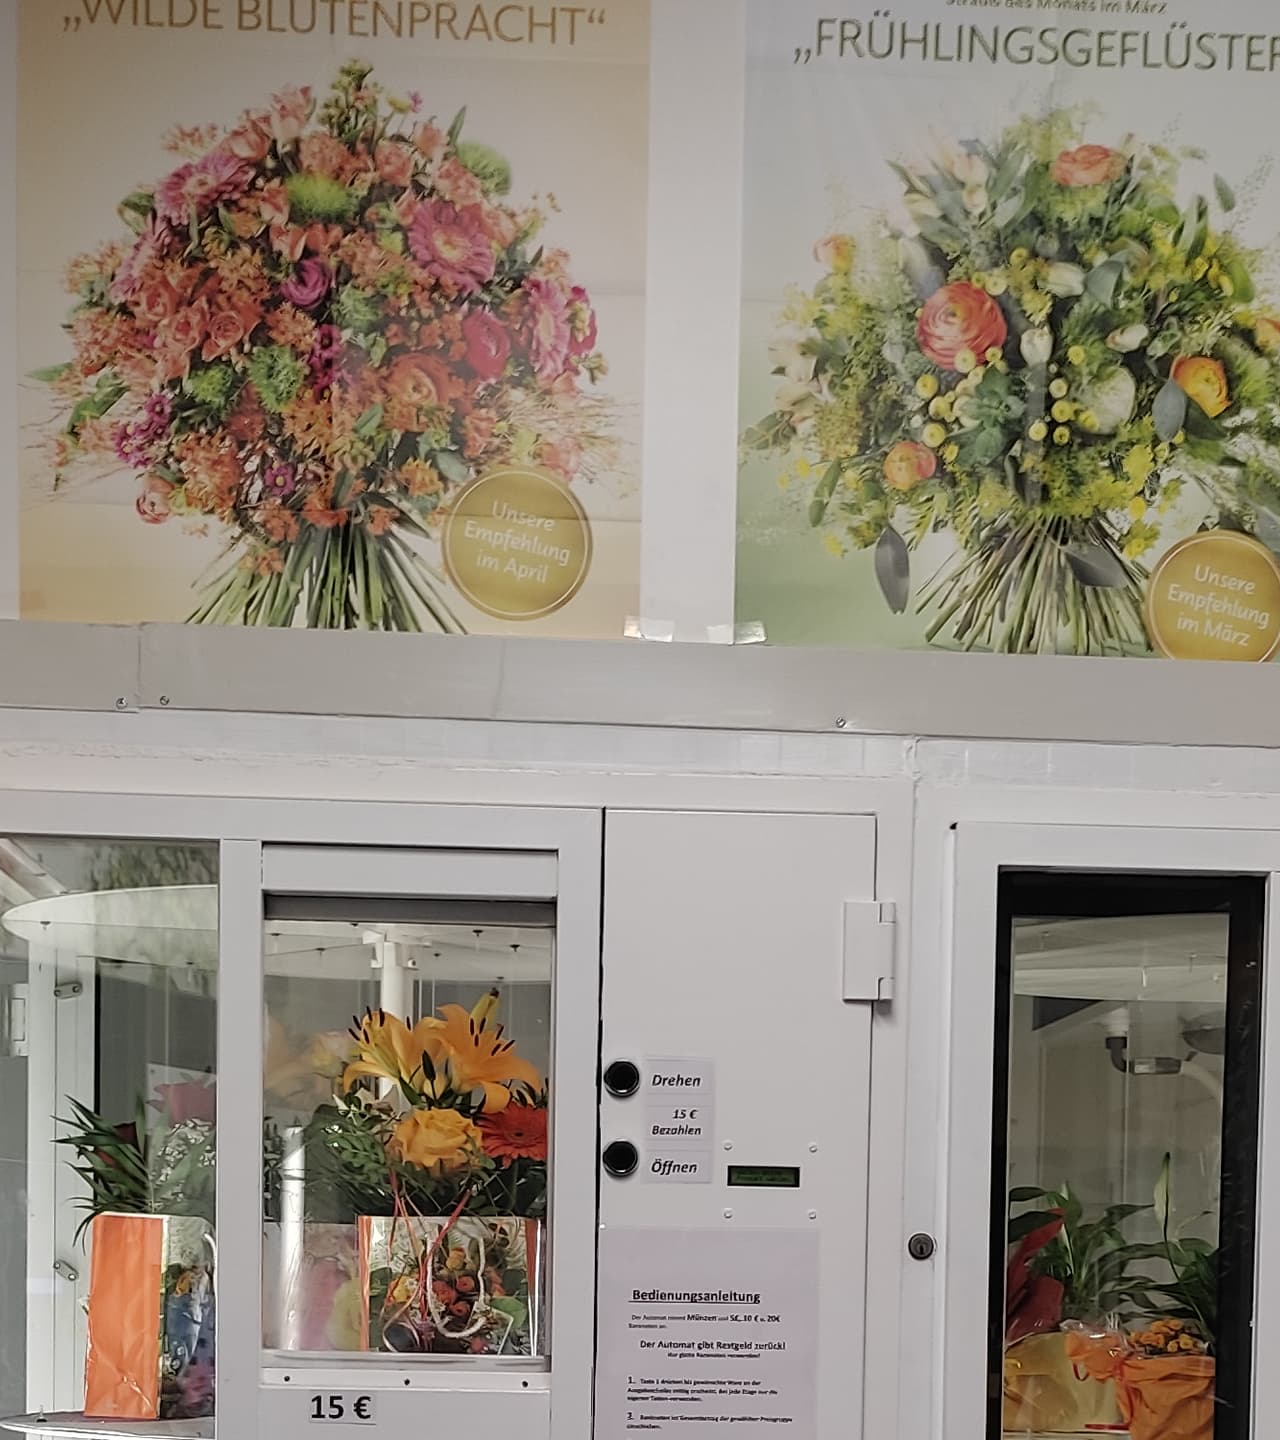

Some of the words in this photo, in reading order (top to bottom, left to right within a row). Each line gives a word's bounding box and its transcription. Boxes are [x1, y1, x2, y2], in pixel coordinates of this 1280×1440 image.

[492, 500, 555, 531] Unsere
[464, 520, 570, 567] Empfehlung
[476, 549, 498, 571] im
[504, 558, 549, 584] April
[1193, 564, 1255, 595] Unsere
[1168, 583, 1271, 630] Empfehlung
[1177, 612, 1198, 633] im
[1203, 619, 1251, 647] März
[651, 1073, 701, 1089] Drehen
[672, 1109, 687, 1120] 15
[689, 1109, 699, 1120] €
[651, 1124, 701, 1136] Bezahlen
[651, 1158, 697, 1175] Öffnen
[632, 1289, 761, 1304] Bedienungsanleitung
[687, 1313, 717, 1323] Münzen
[640, 1340, 655, 1350] Der
[657, 1340, 695, 1350] Automat
[697, 1340, 714, 1351] gibt
[311, 1395, 344, 1419] 15
[353, 1395, 372, 1419] €
